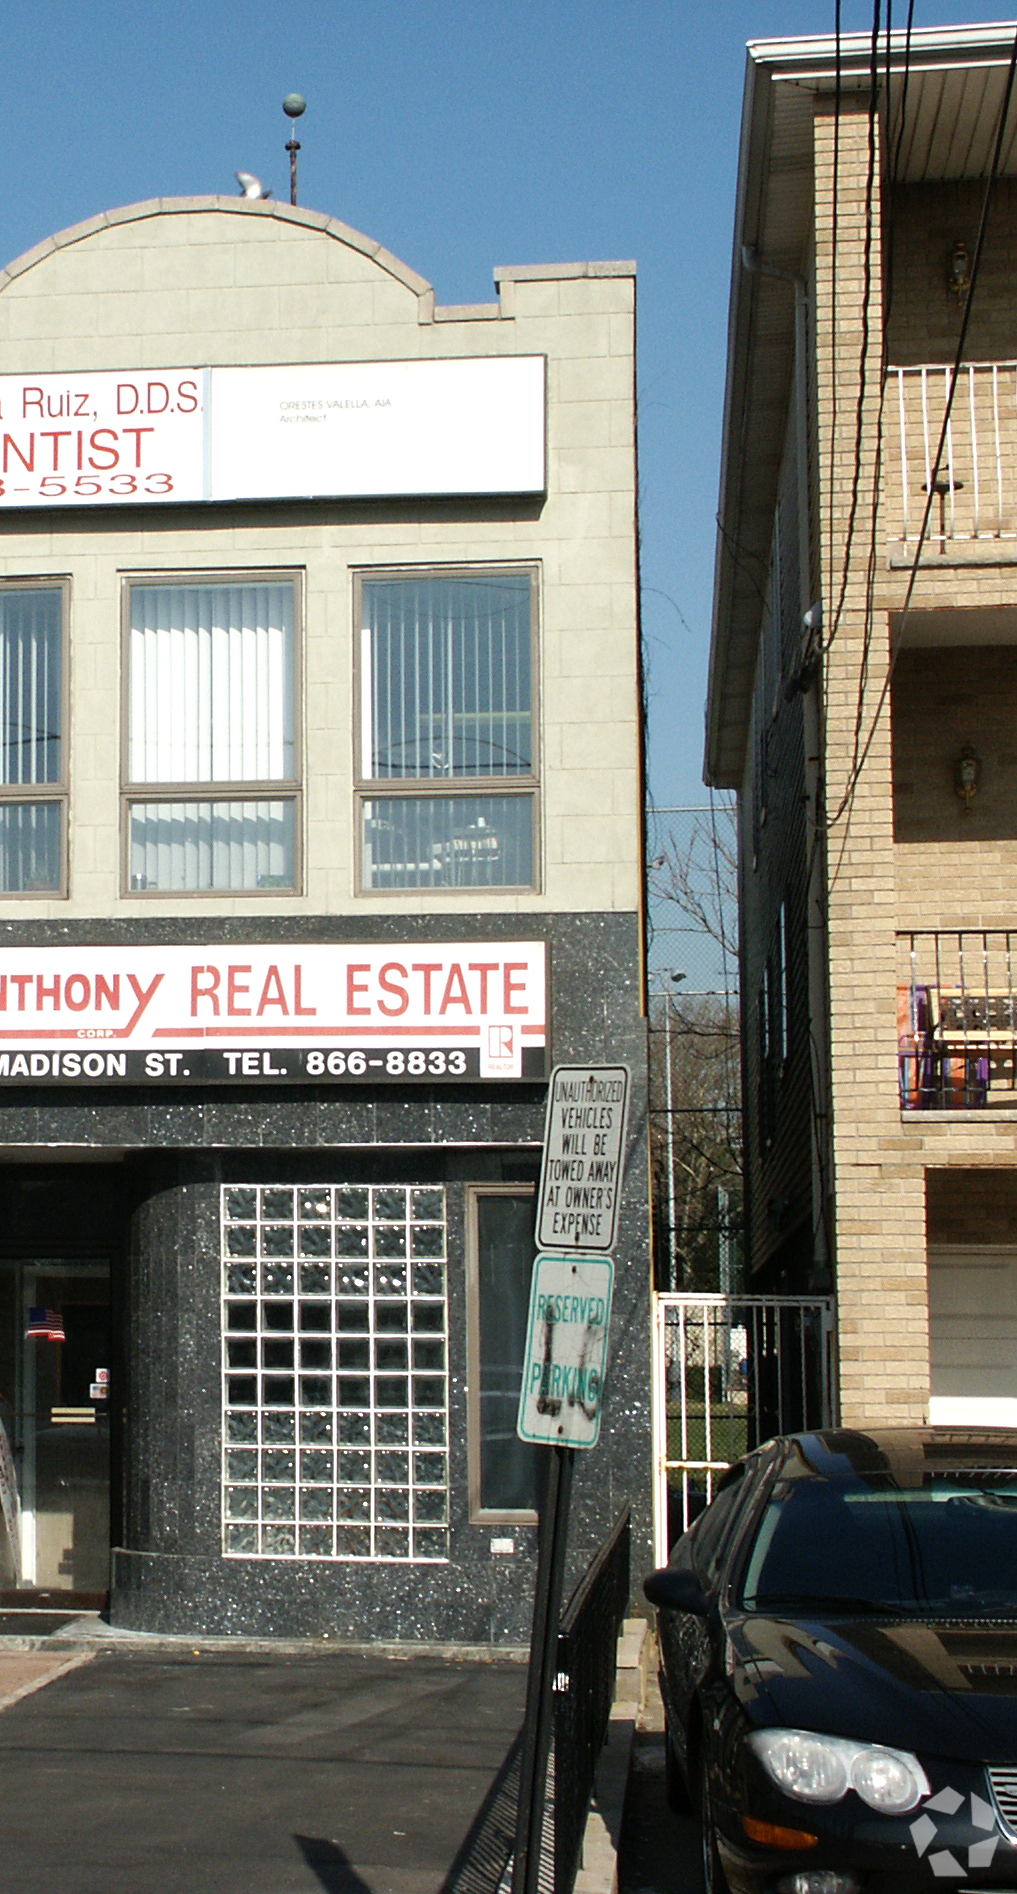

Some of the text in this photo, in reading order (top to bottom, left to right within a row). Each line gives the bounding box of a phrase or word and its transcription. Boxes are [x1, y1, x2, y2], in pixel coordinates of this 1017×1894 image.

[22, 386, 99, 421] Ruiz,
[279, 400, 323, 411] ORESTES
[279, 414, 327, 424] Architect
[190, 964, 318, 1018] REAL
[346, 961, 529, 1018] ESTATE
[144, 1052, 190, 1077] ST.
[223, 1051, 288, 1076] TEL.
[306, 1050, 467, 1075] 866-8833
[554, 1080, 623, 1103] UNAUTHORIZED
[561, 1107, 613, 1129] VEHICLES
[562, 1134, 608, 1156] WILL BE
[549, 1159, 617, 1183] TOWED AWAY
[546, 1186, 613, 1209] AT OWNER'S
[552, 1212, 603, 1236] EXPENSE
[536, 1294, 605, 1326] RESERVED
[530, 1362, 599, 1402] PARKING
